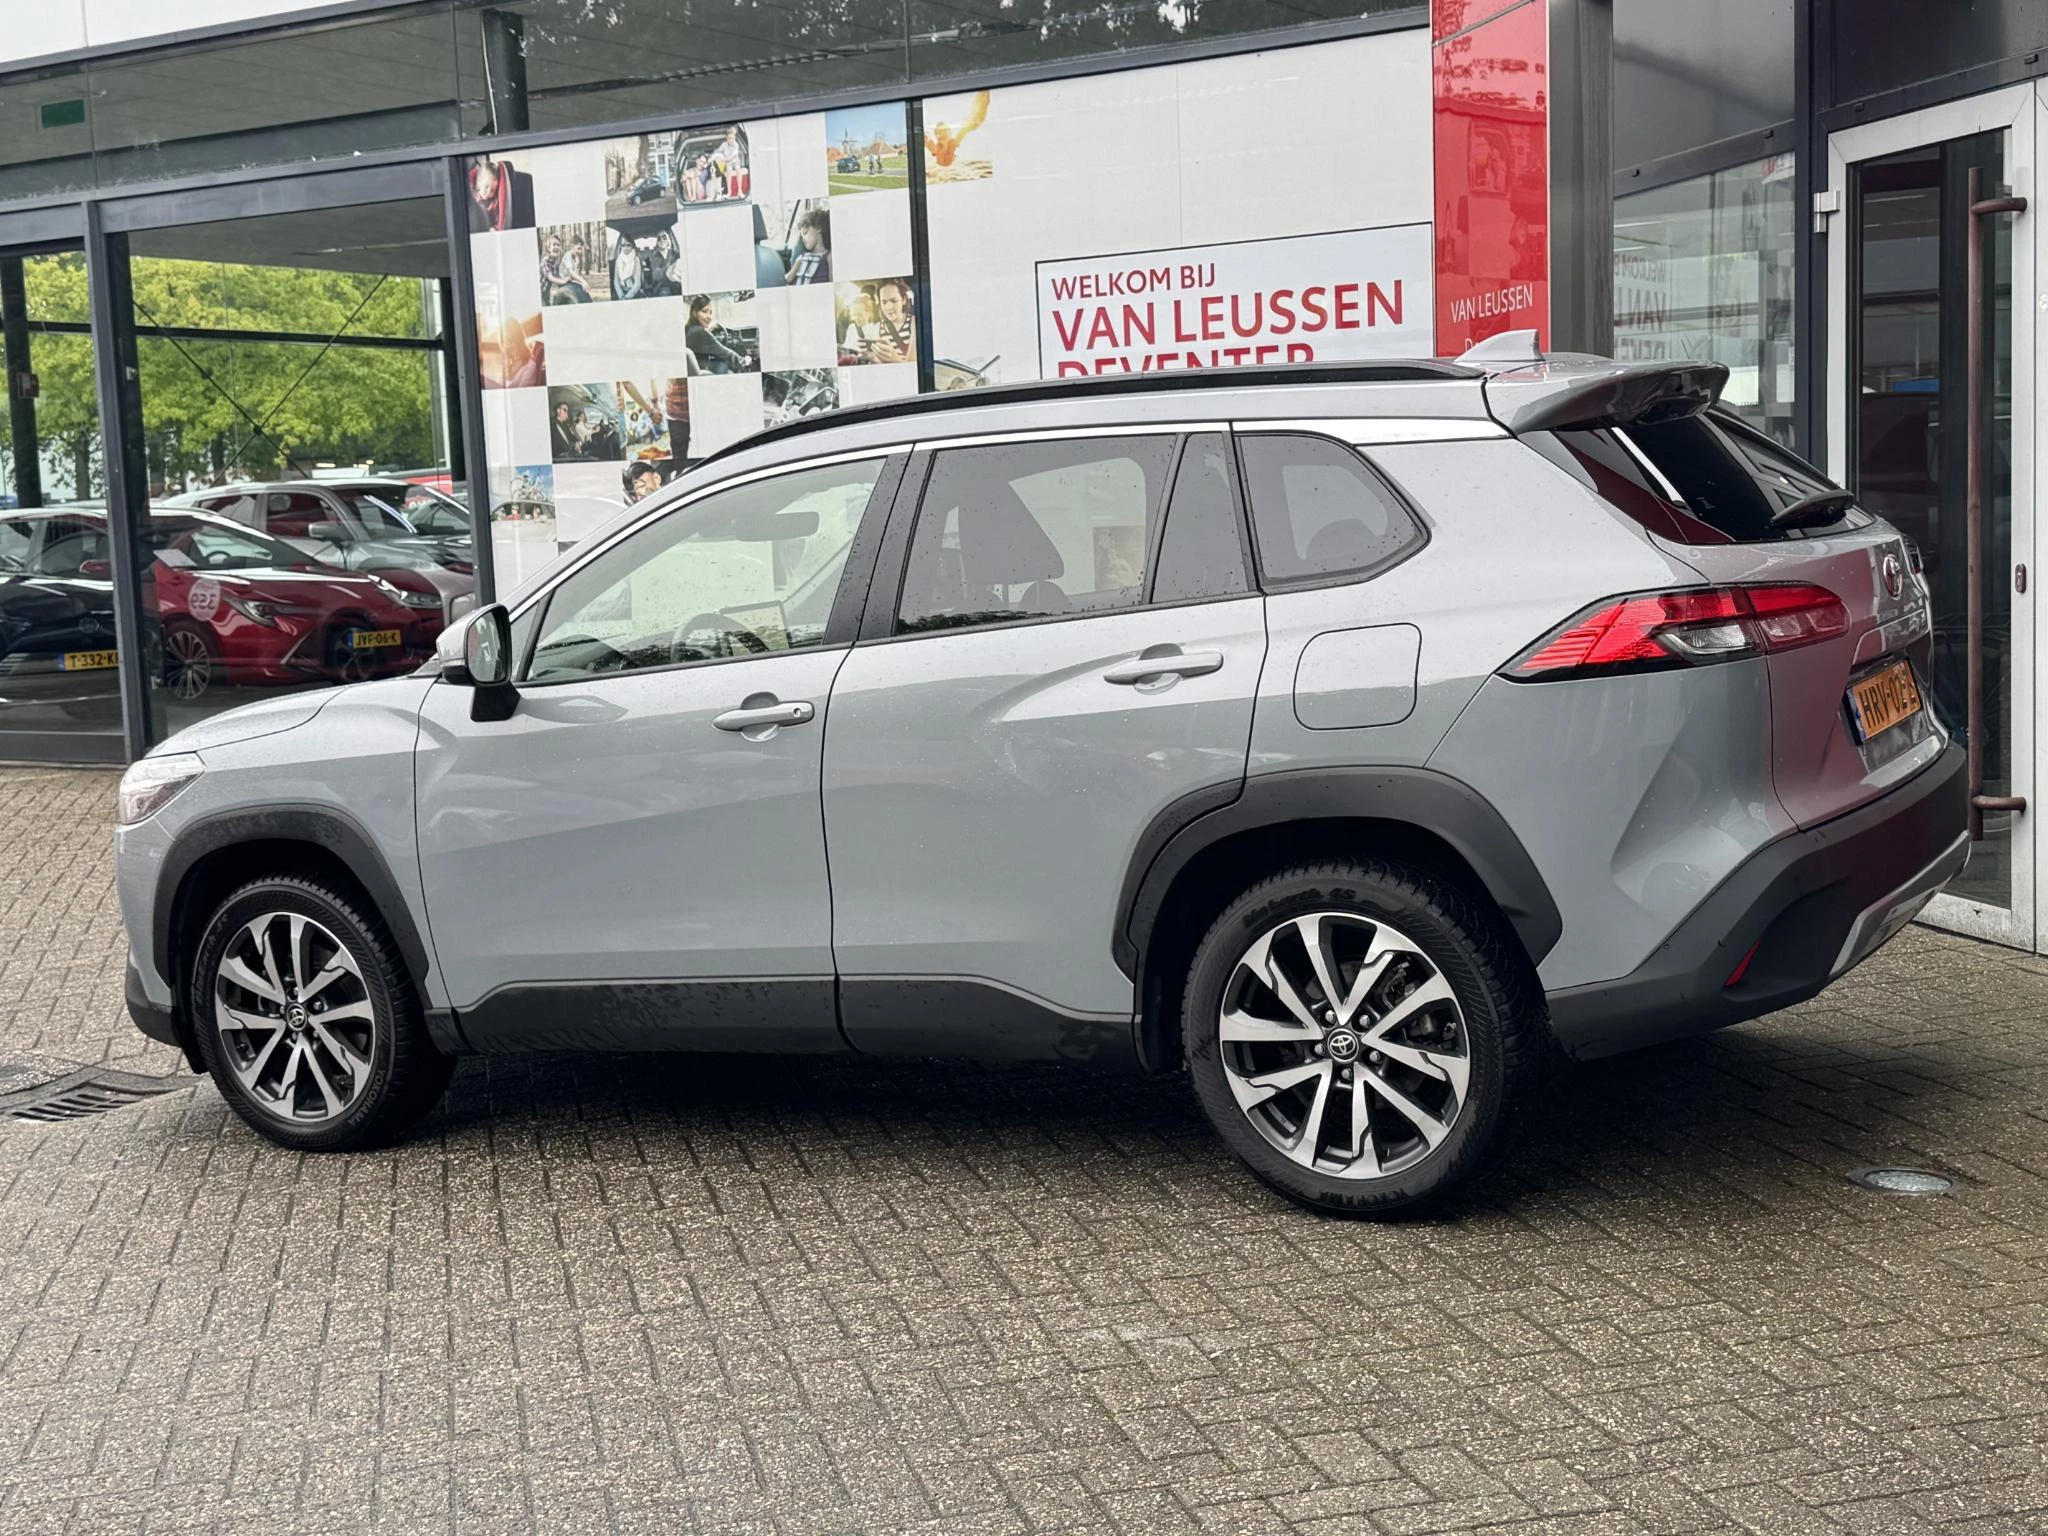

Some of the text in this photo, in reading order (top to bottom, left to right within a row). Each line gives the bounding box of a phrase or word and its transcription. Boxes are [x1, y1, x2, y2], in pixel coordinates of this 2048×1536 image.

[1051, 262, 1215, 301] WELKOM BIJ
[1451, 283, 1533, 323] VAN LEUSSEN
[1052, 279, 1403, 351] VAN LEUSSEN
[346, 1069, 386, 1126] YOKOHAMA
